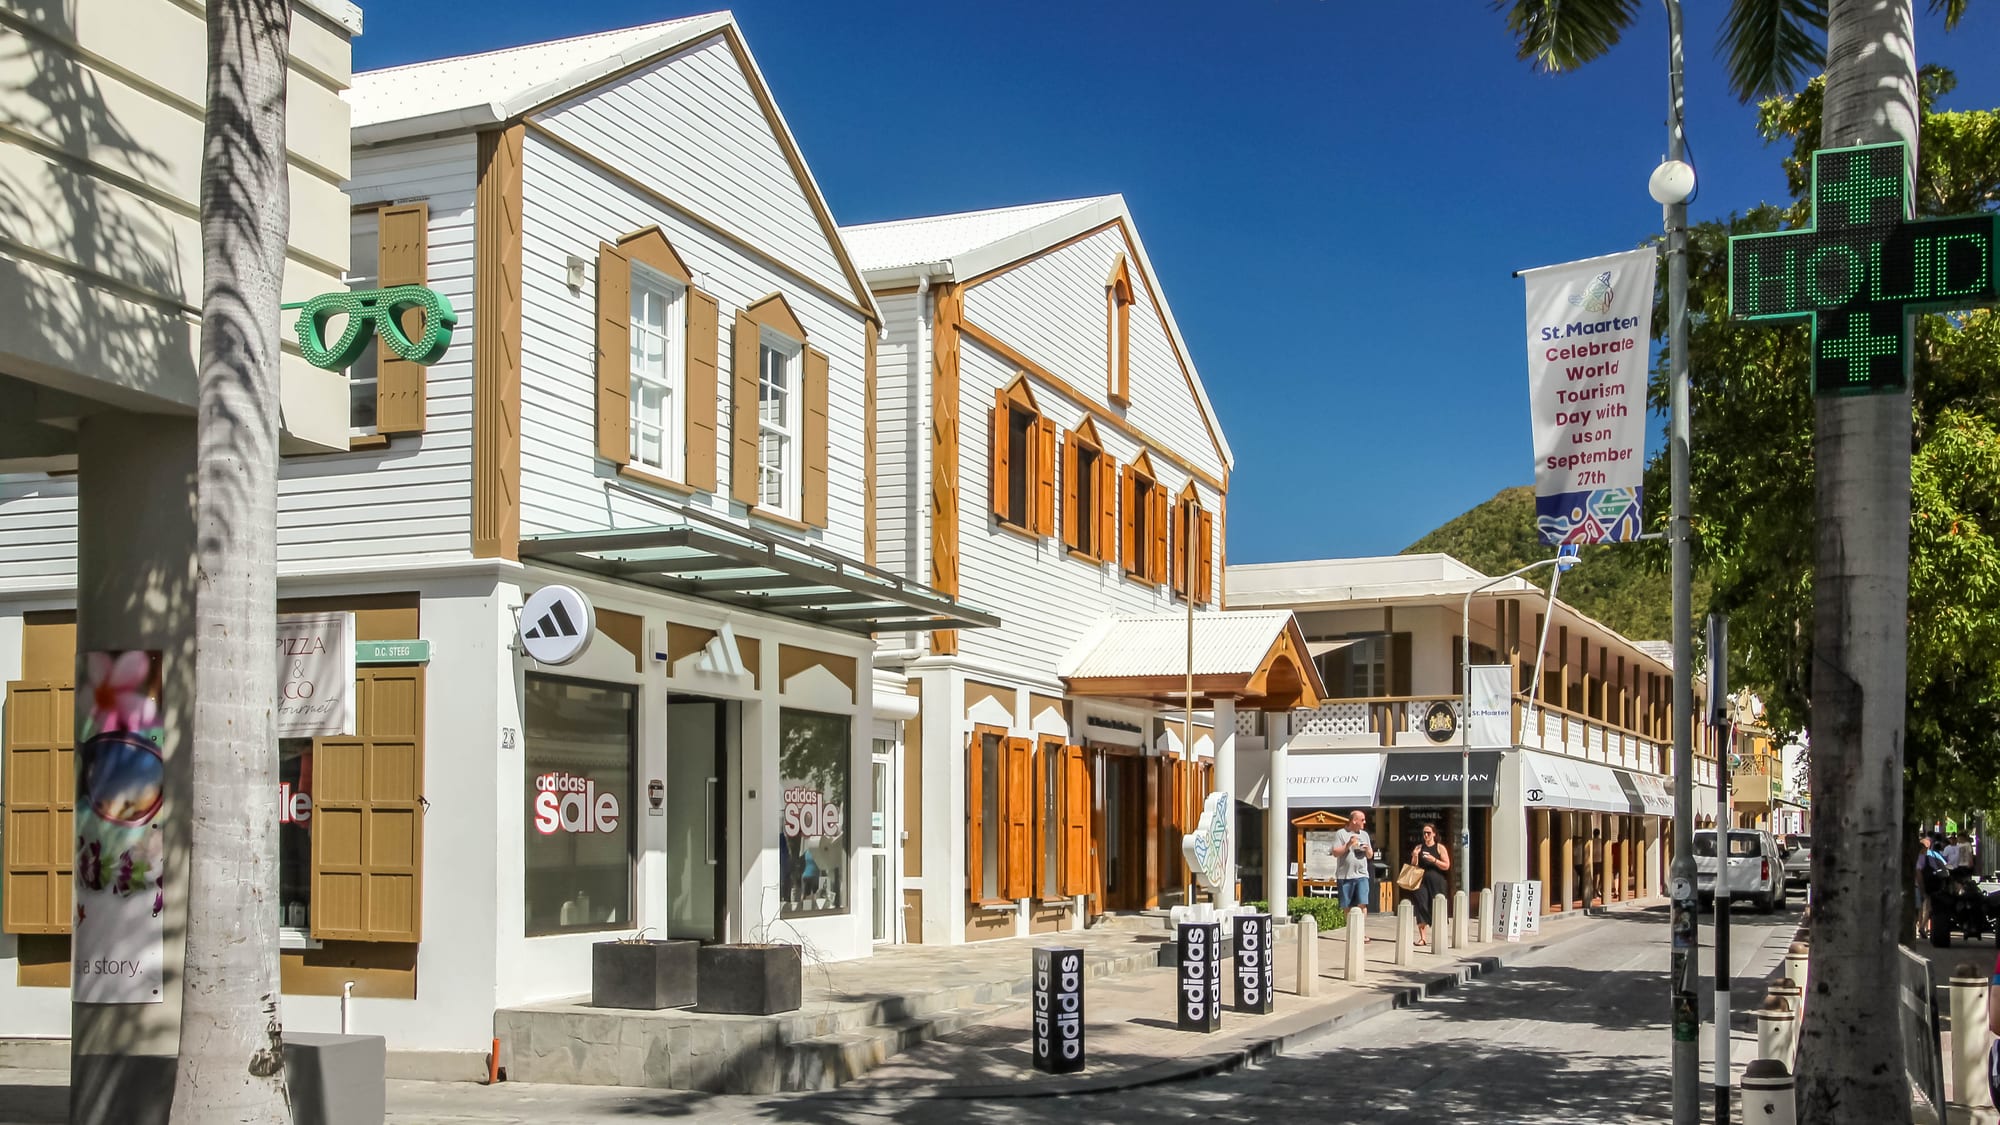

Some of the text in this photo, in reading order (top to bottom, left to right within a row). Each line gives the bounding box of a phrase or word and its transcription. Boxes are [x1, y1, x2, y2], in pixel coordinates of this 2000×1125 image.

[1749, 234, 1987, 311] HOLID
[1541, 315, 1640, 341] St. Maarten
[1545, 337, 1634, 362] Celebrate
[1565, 360, 1620, 381] World
[1556, 382, 1625, 404] Tourism
[1555, 402, 1628, 427] Day with
[1572, 427, 1612, 444] us on
[1547, 447, 1633, 472] September
[1577, 470, 1606, 486] 27th
[375, 647, 410, 657] D.C. STEEG
[292, 659, 305, 678] &
[284, 681, 314, 699] CO
[536, 772, 586, 792] adidas
[1332, 775, 1359, 784] COIN
[1390, 774, 1430, 782] DAVID
[280, 783, 312, 823] le
[535, 780, 619, 834] sale
[784, 787, 818, 803] adidas
[784, 793, 840, 838] sale
[83, 960, 90, 975] a
[94, 956, 143, 978] story.
[1211, 927, 1220, 1020] adidas
[1239, 920, 1259, 1005] adidas
[1265, 918, 1273, 1004] adidas
[1183, 928, 1205, 1021] adidas
[1035, 954, 1049, 1058] adidas
[1057, 954, 1079, 1060] adidas
